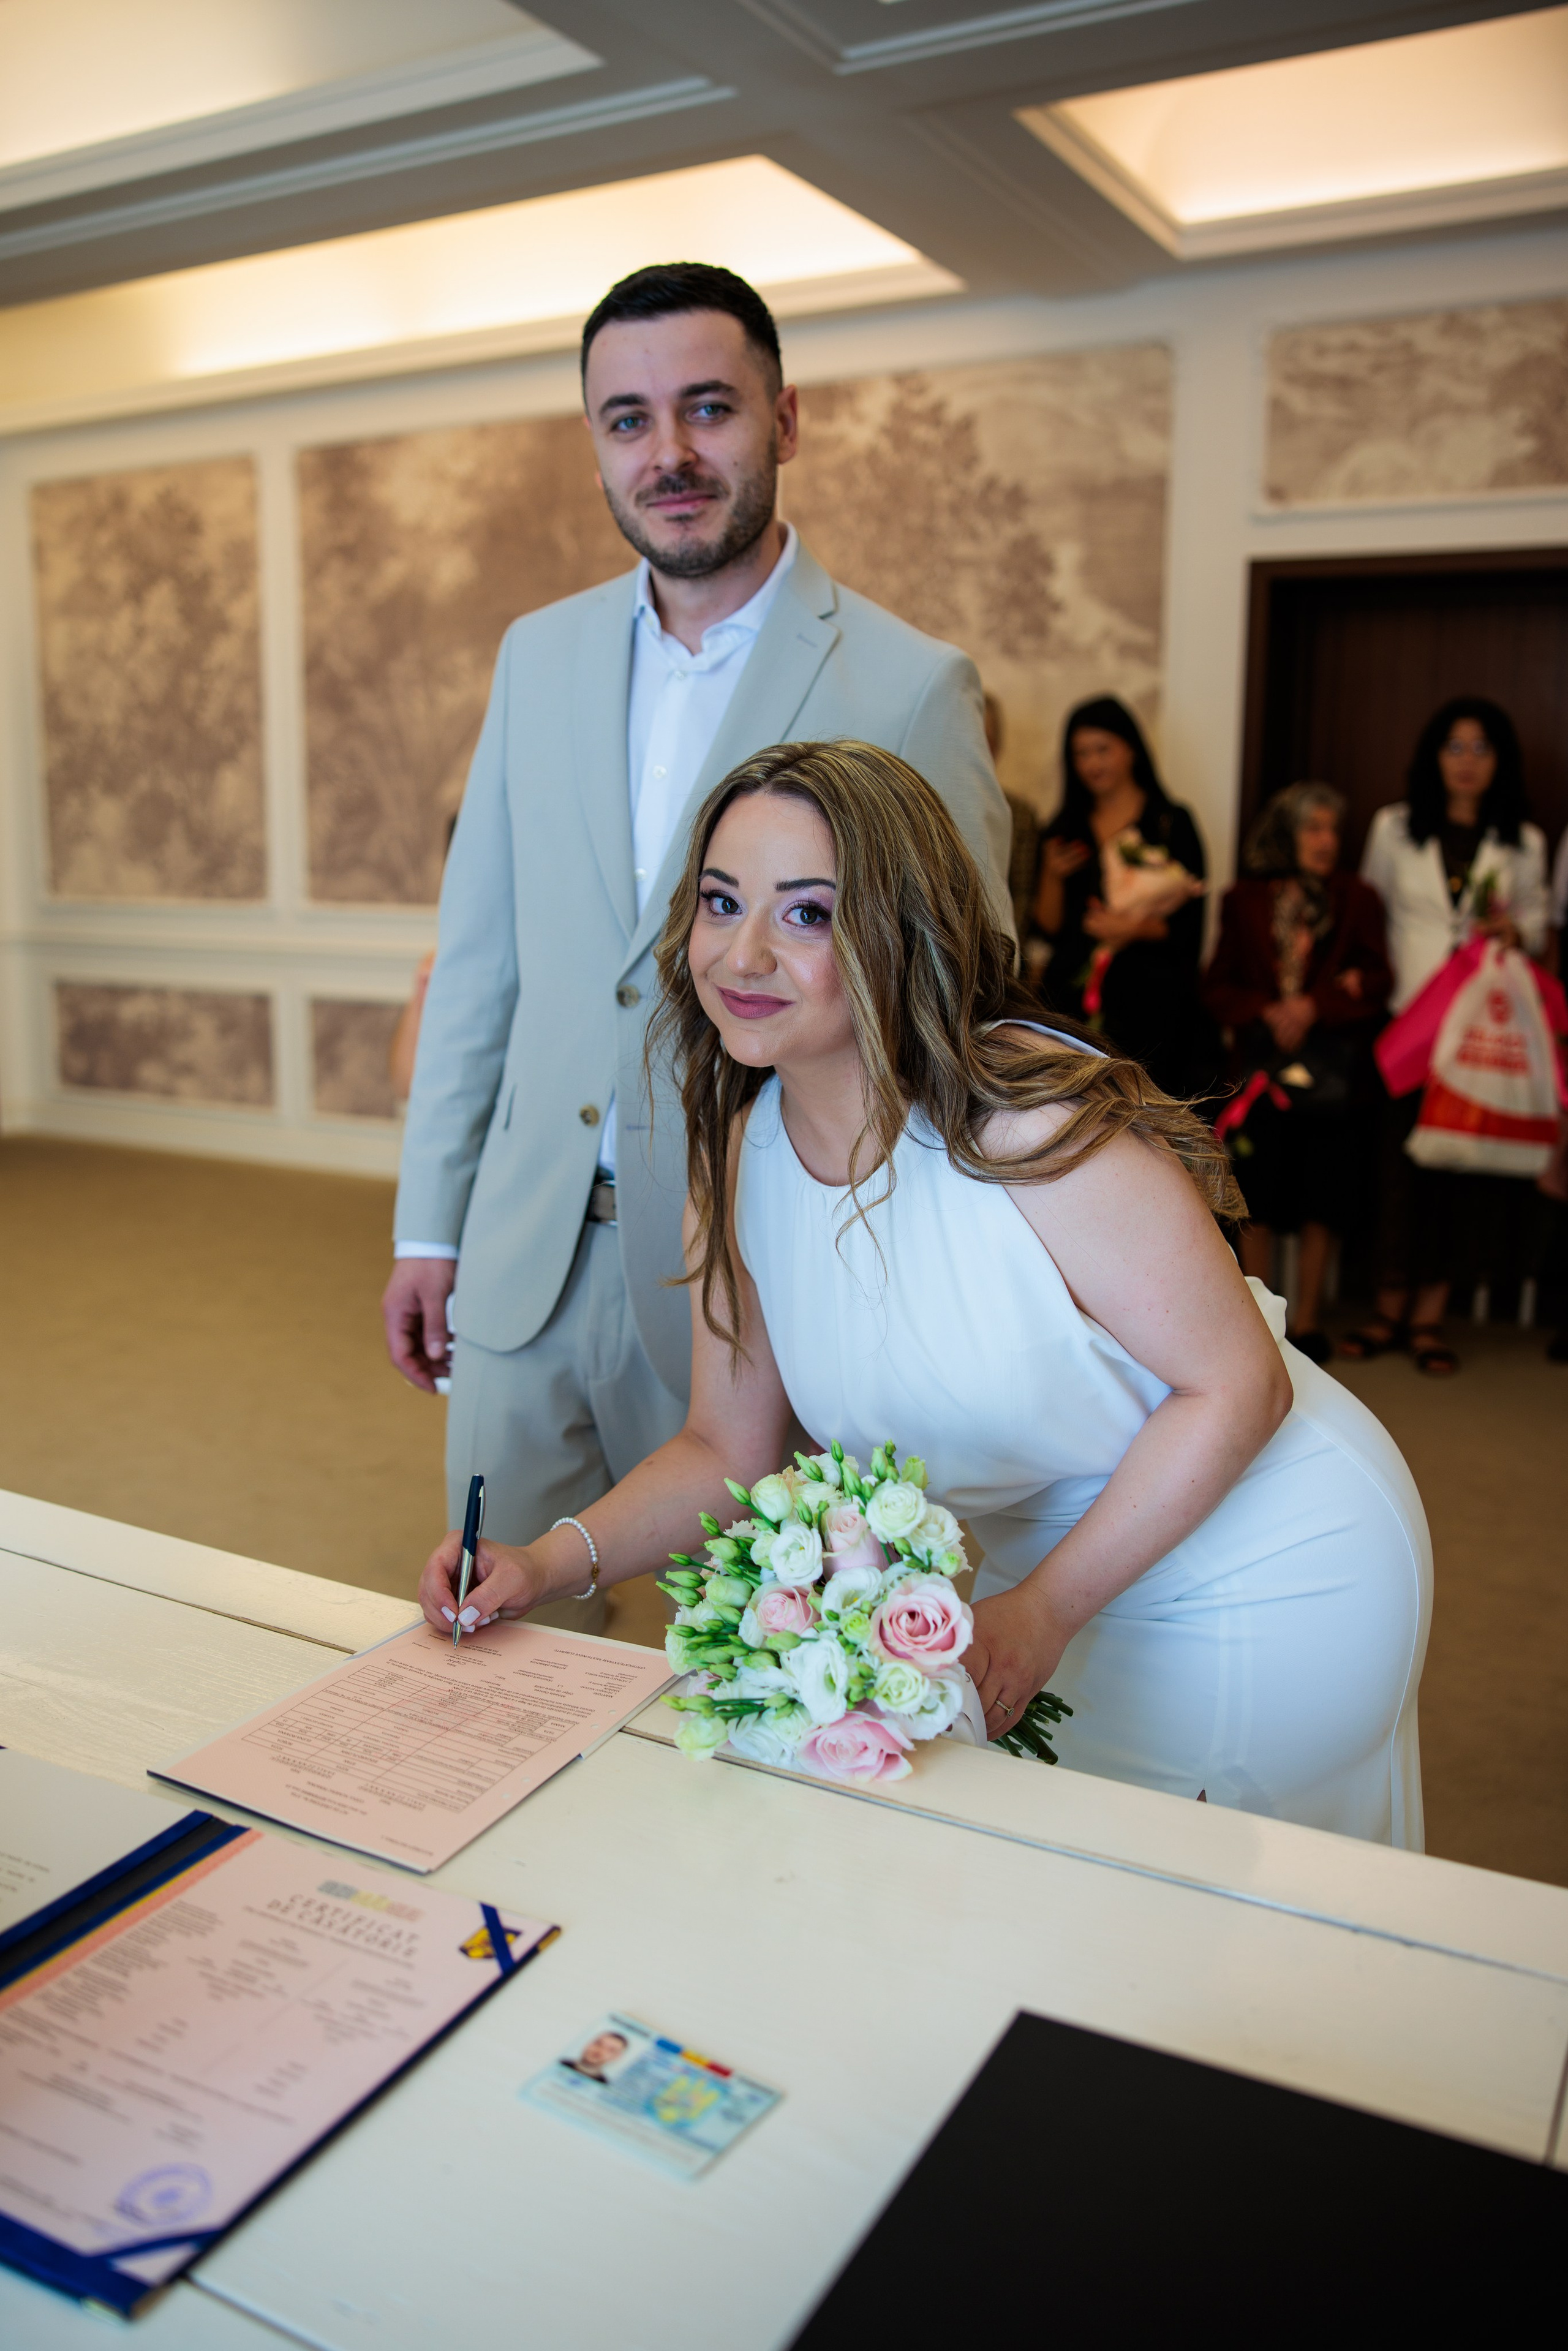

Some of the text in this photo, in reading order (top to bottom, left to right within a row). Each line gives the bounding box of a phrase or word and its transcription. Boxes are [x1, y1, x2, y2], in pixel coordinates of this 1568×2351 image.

[601, 1659, 646, 1669] CERTIFICATE/EXTRASE
[266, 1898, 295, 1915] DE
[288, 1893, 421, 1944] CERTIFICAT
